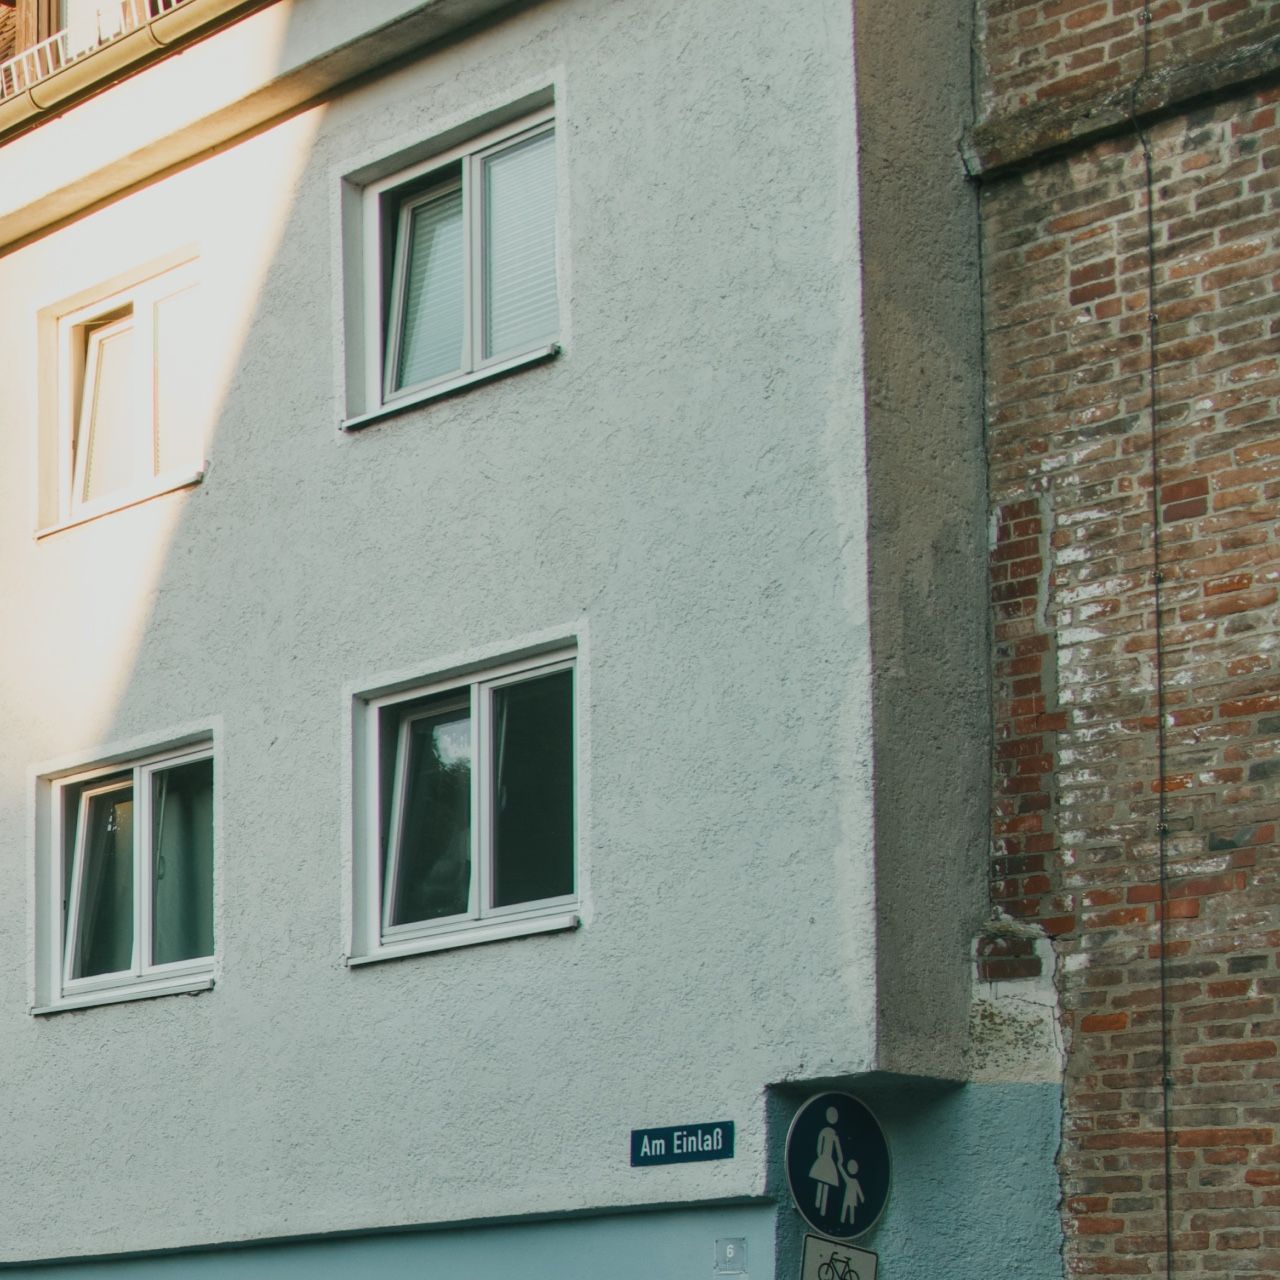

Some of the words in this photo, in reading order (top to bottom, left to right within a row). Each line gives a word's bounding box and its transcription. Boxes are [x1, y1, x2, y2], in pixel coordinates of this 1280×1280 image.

[640, 1134, 665, 1157] Am
[673, 1127, 722, 1154] Einlaß
[726, 1243, 735, 1259] 6
